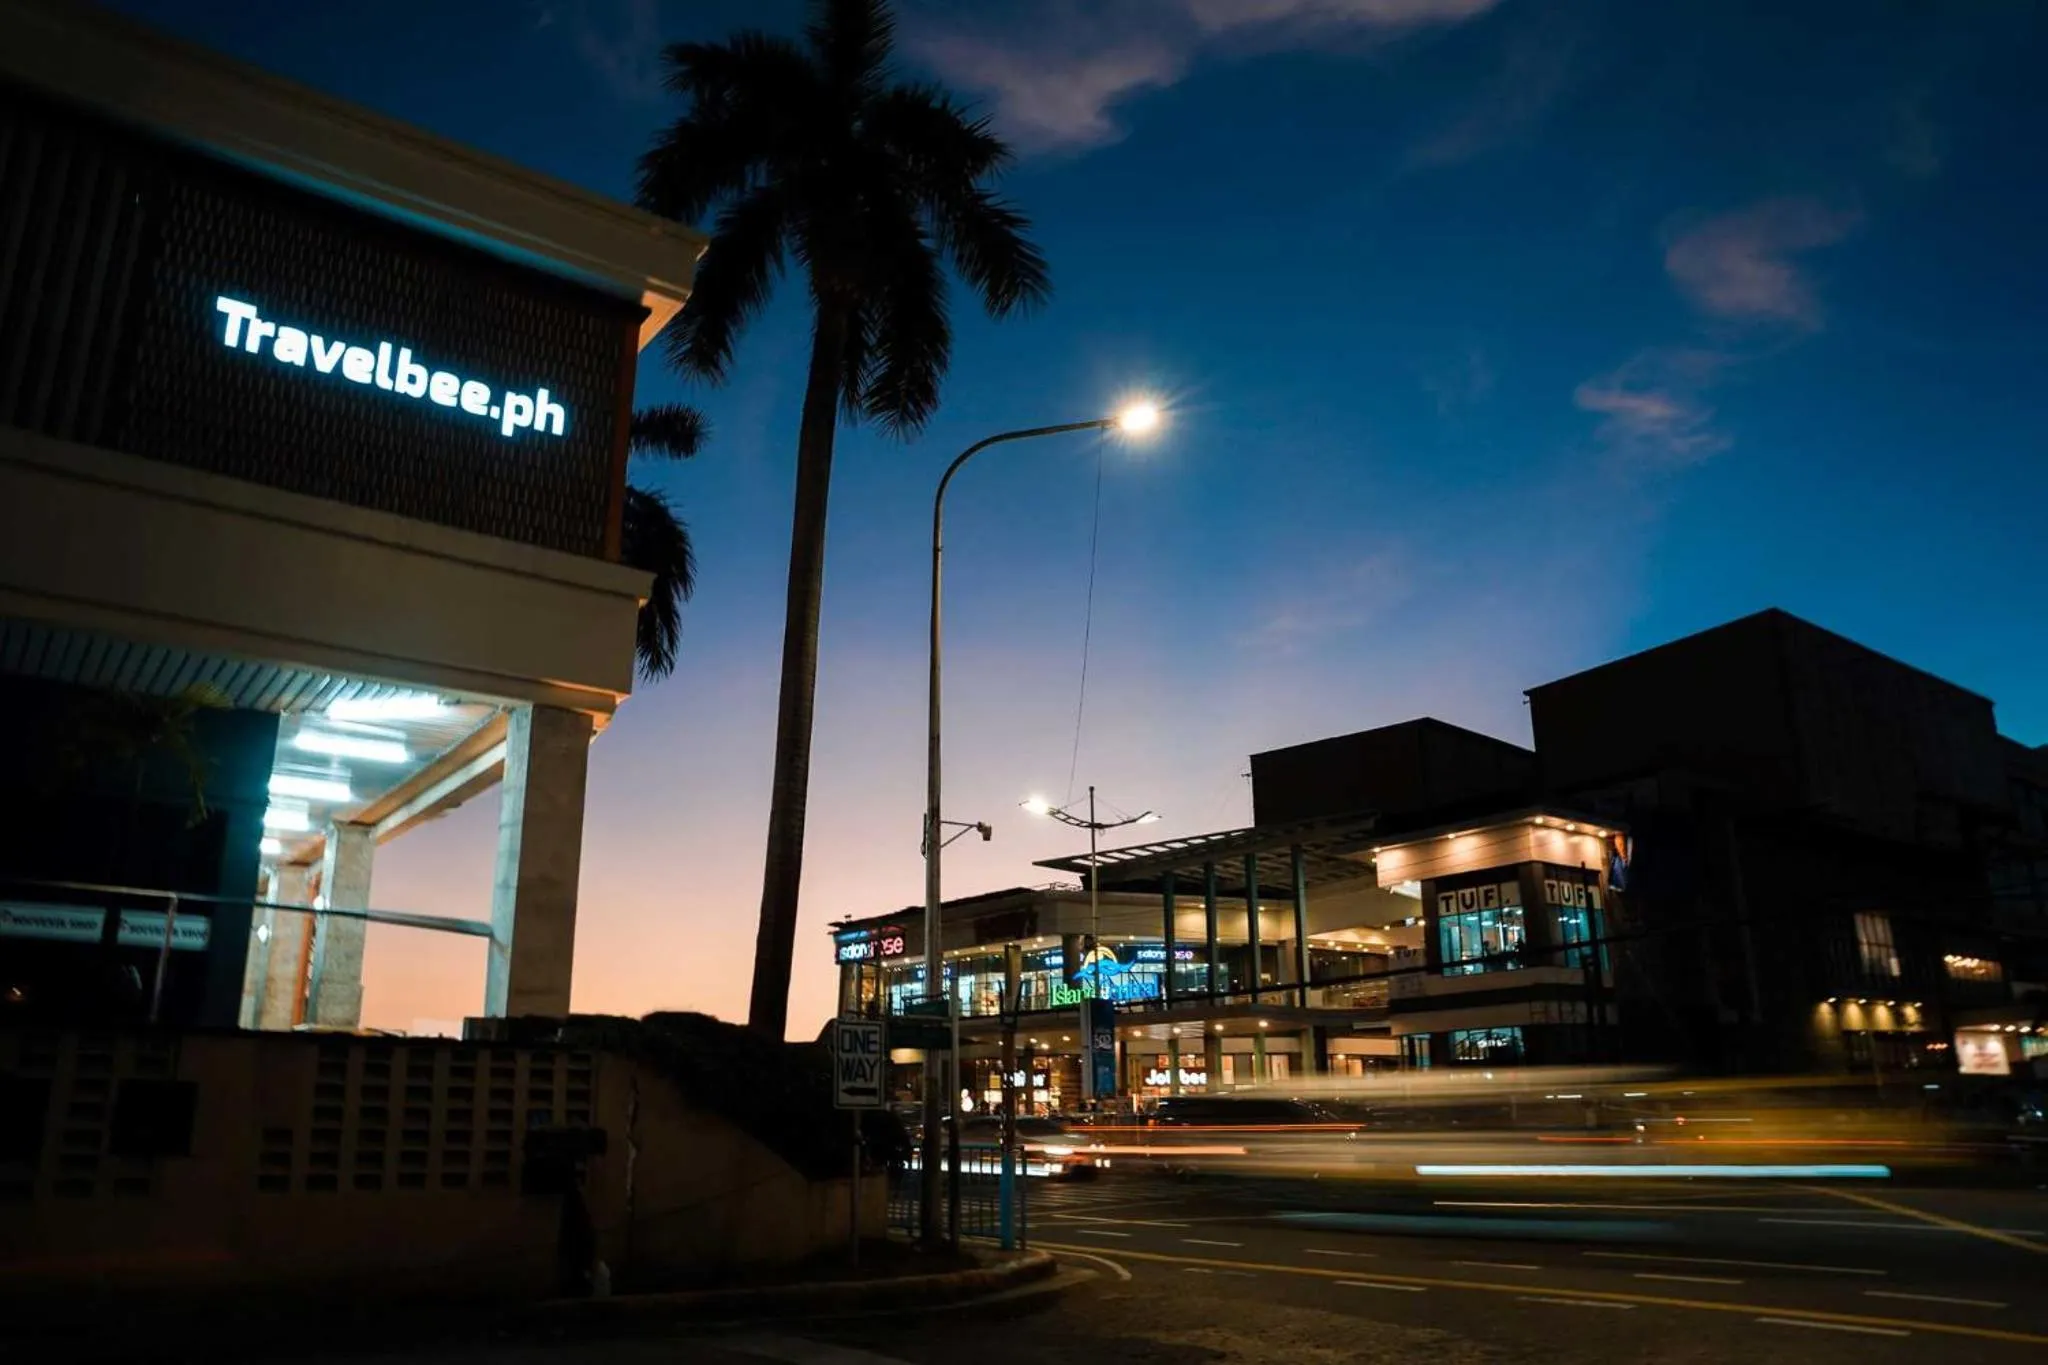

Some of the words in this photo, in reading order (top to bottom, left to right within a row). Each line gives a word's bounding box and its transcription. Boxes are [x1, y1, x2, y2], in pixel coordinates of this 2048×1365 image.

[216, 295, 566, 437] Travelbee.ph
[841, 1030, 878, 1053] ONE
[839, 1056, 878, 1082] WAY
